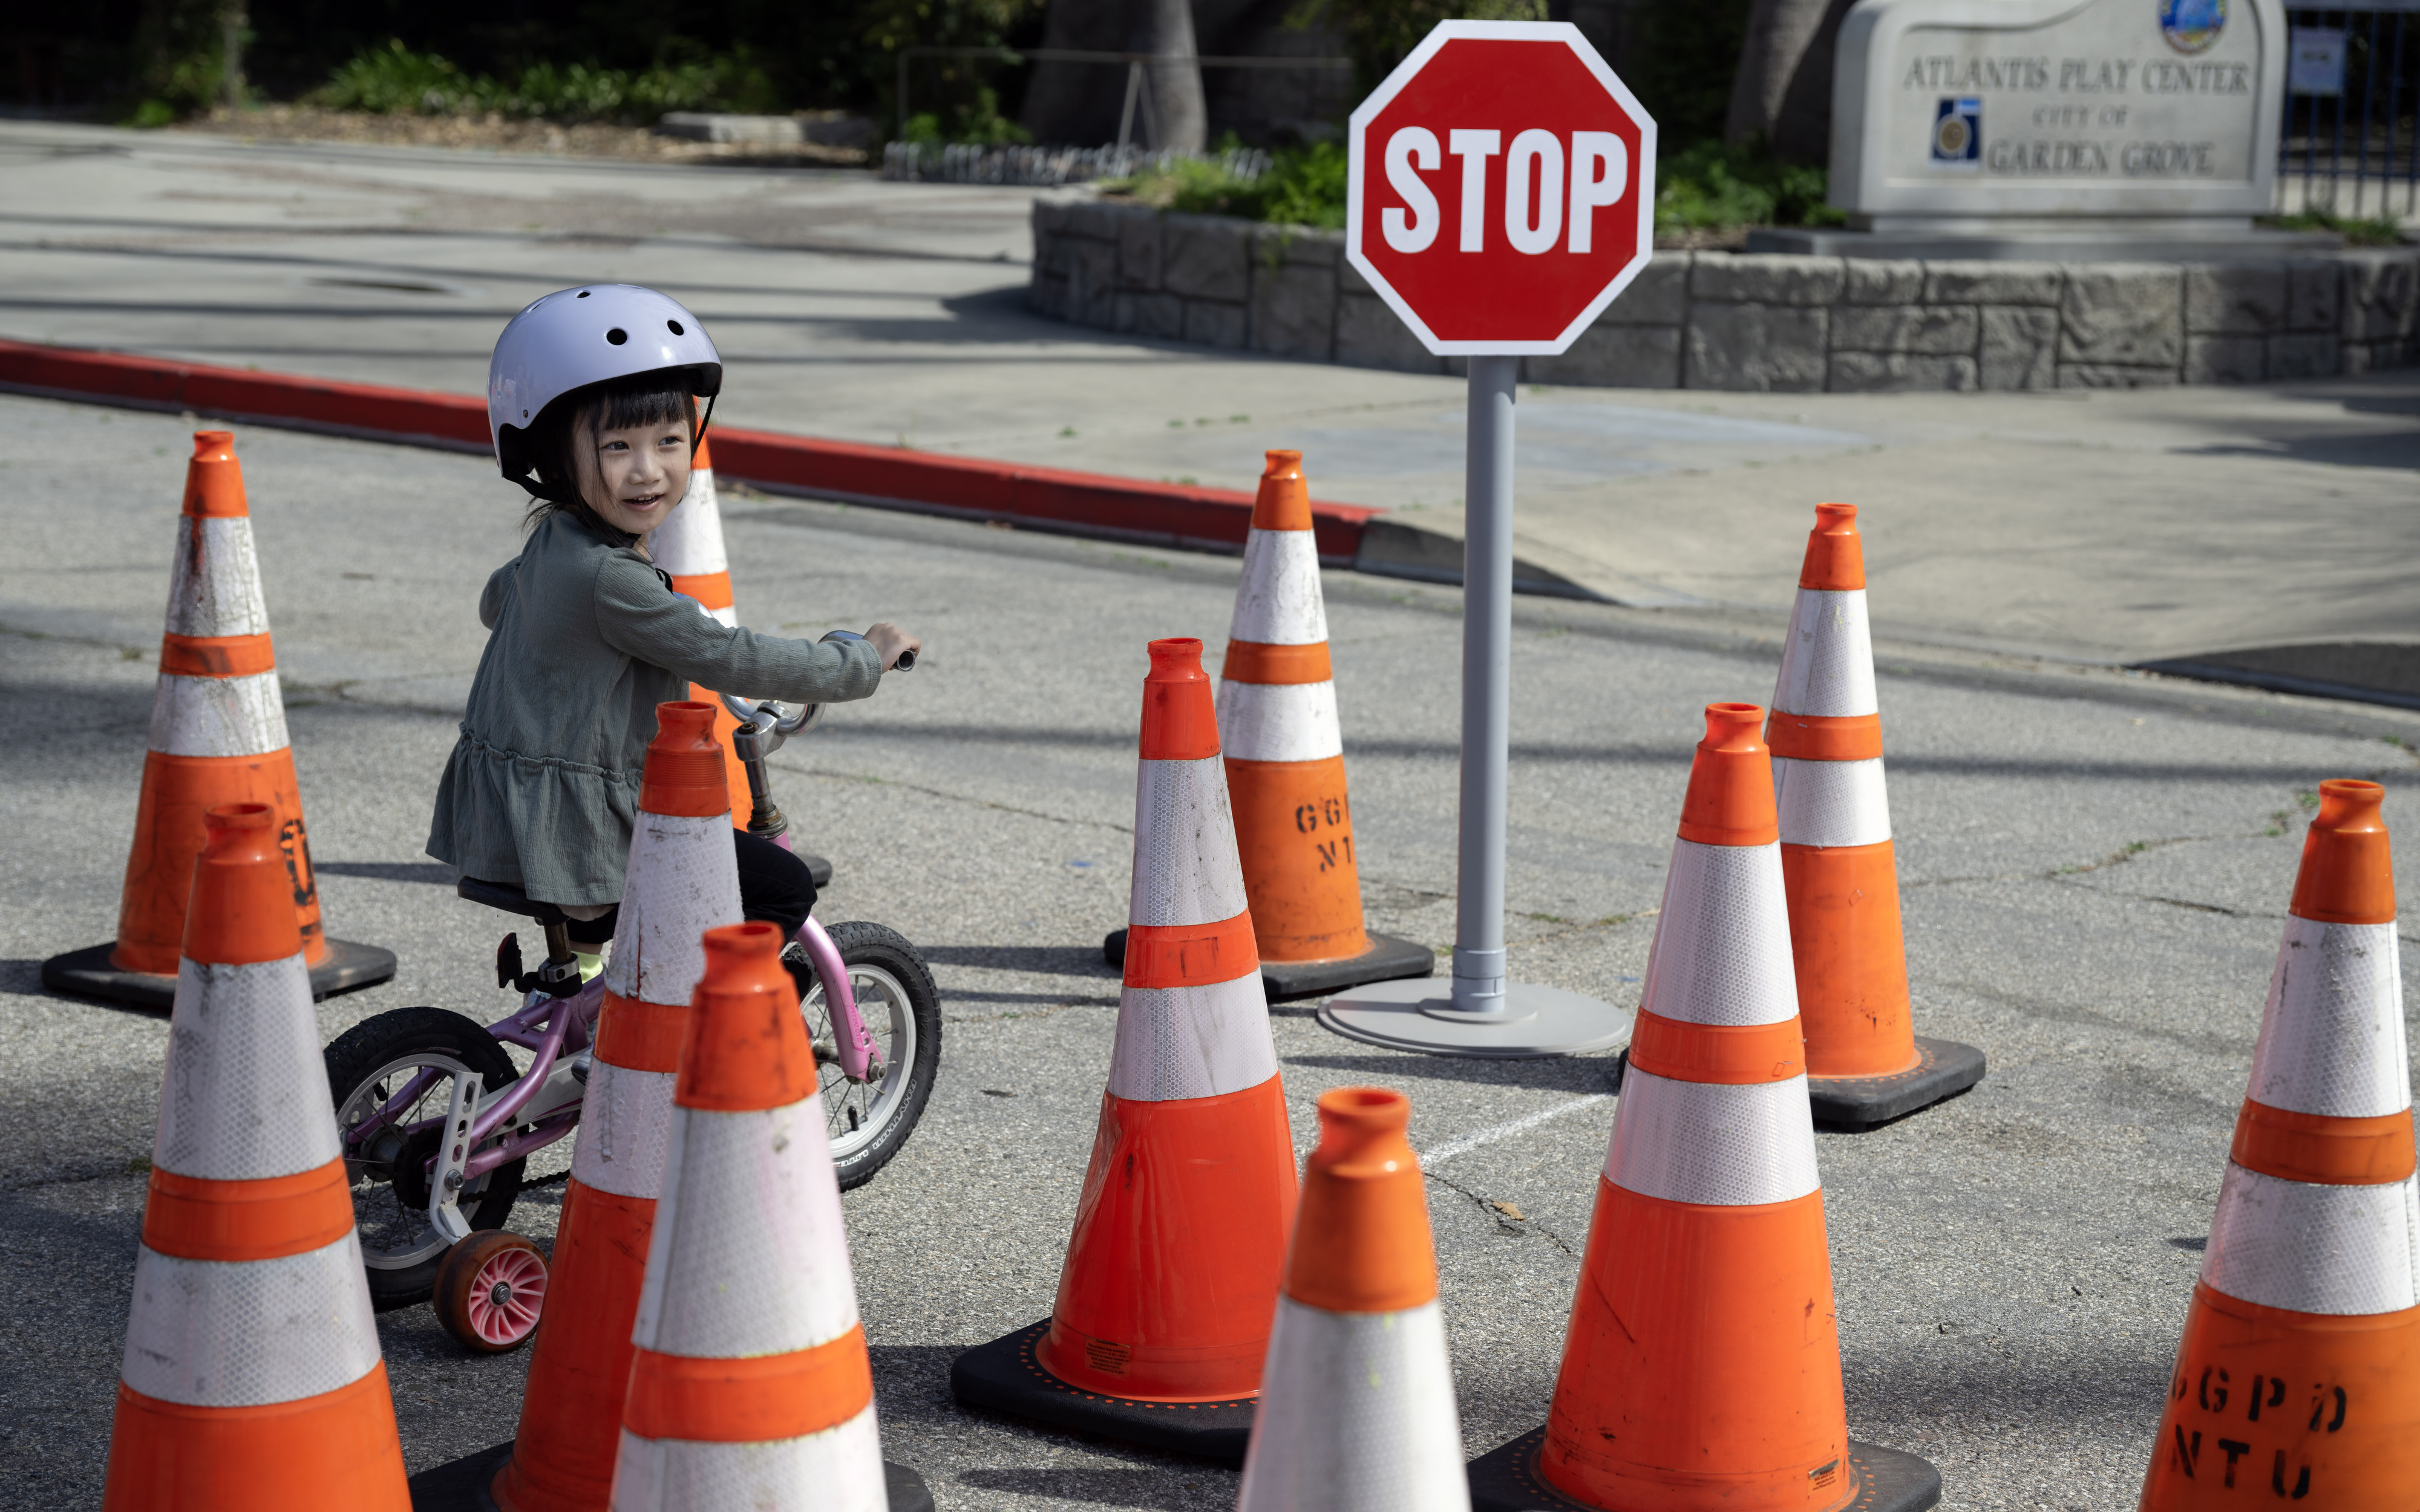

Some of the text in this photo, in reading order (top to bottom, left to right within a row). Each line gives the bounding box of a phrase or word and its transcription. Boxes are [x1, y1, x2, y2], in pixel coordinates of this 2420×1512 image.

[1903, 56, 2249, 95] ATLANTIS PLAY CENTER
[2032, 104, 2131, 130] CITY OF
[1987, 139, 2216, 176] GARDEN GROVE
[1382, 126, 1628, 255] STOP
[1295, 793, 1350, 833] GG
[840, 1078, 917, 1167] RHYTHM LITE
[2170, 1423, 2311, 1500] NTU
